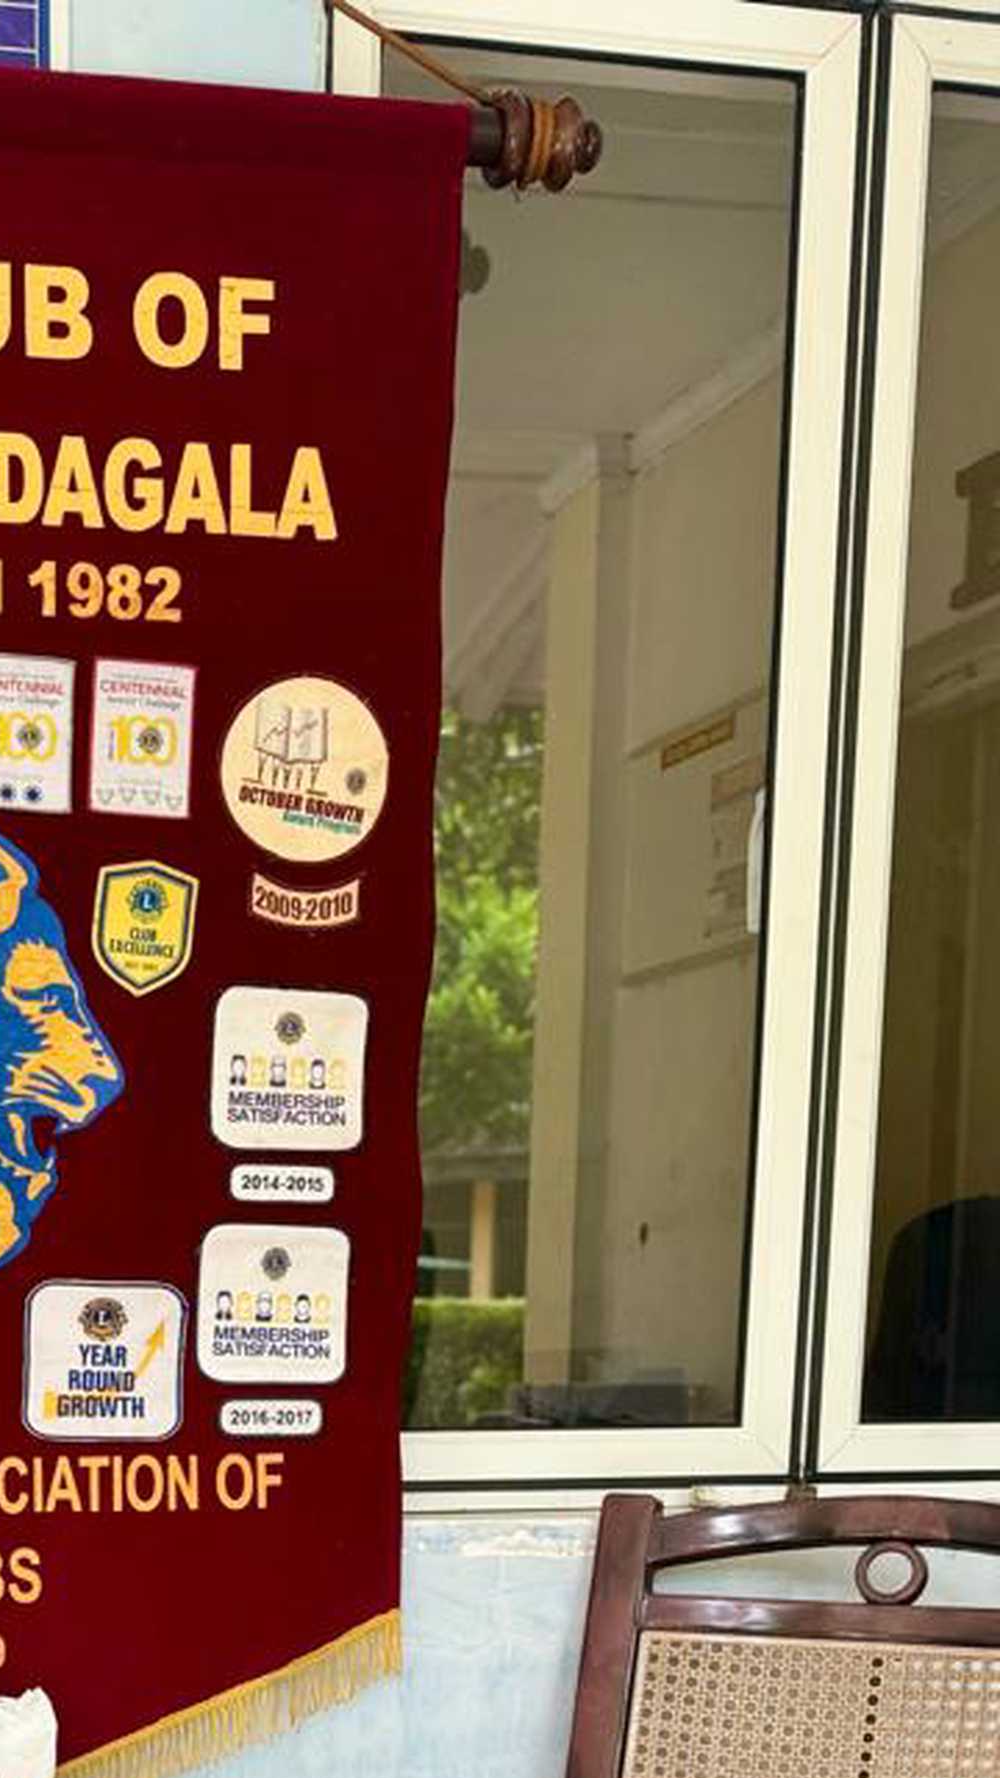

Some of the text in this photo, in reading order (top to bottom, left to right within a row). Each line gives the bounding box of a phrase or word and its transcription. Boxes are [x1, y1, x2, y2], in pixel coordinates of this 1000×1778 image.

[133, 272, 276, 371] OF
[27, 559, 182, 622] 1982
[99, 679, 188, 699] CENTENNIAL
[238, 784, 365, 823] OCTOBER GROWTH
[254, 885, 352, 921] 2009-2010
[228, 1090, 346, 1110] MEMBERSHIP
[226, 1107, 346, 1126] SATISFACTION
[240, 1174, 325, 1192] 2014-2015
[213, 1326, 330, 1344] MEMBERSHIP
[78, 1344, 128, 1368] YEAR
[211, 1341, 331, 1359] SATISFACTION
[68, 1369, 136, 1393] ROUND
[57, 1394, 146, 1419] GROWTH
[229, 1409, 313, 1426] 2016-2017
[214, 1452, 285, 1511] OF
